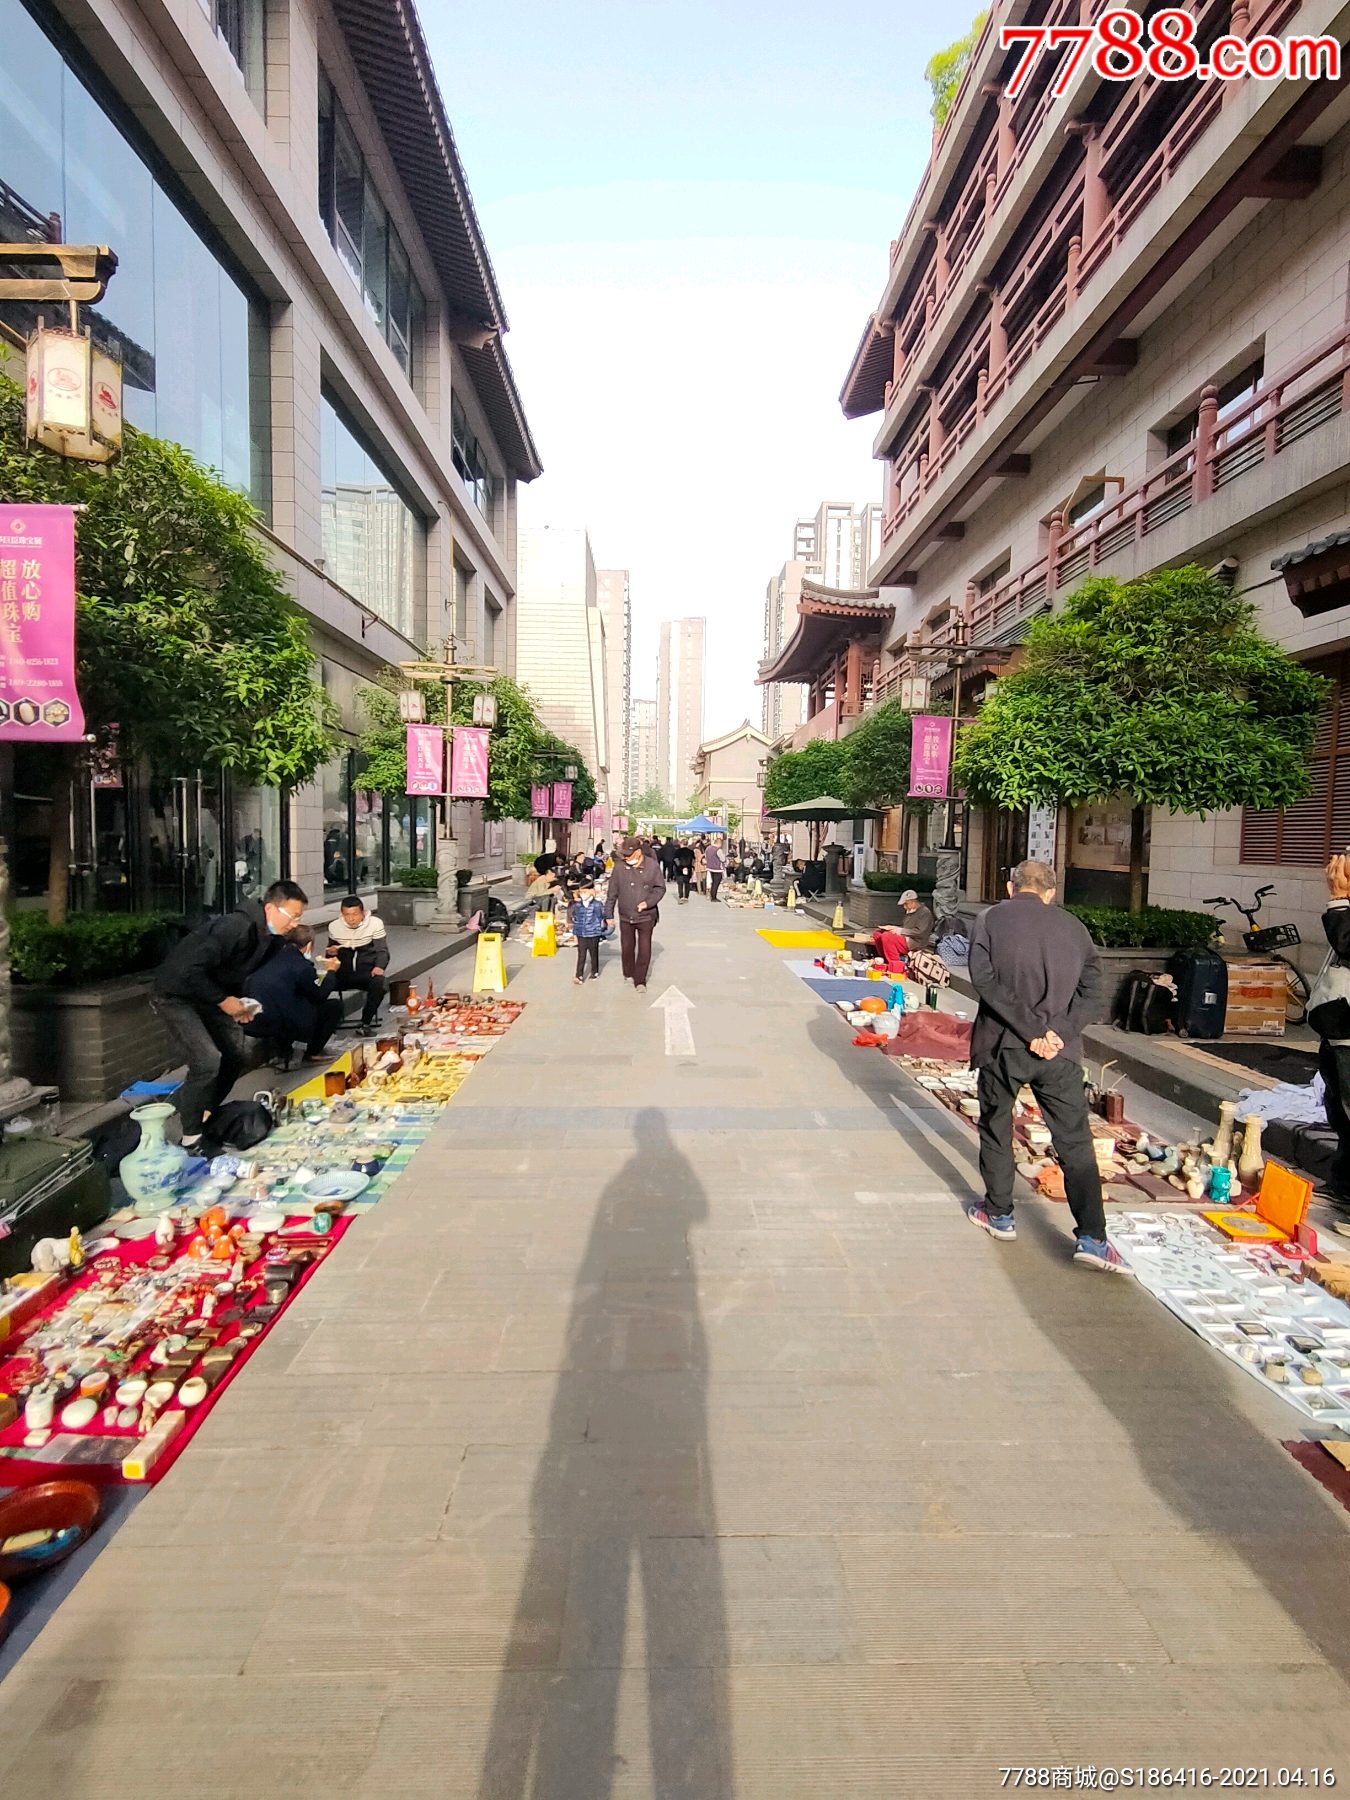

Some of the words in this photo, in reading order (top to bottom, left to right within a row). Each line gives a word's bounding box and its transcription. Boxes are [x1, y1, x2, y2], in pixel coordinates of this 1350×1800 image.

[0, 559, 23, 643] 超值珠宝
[21, 559, 41, 621] 放心购
